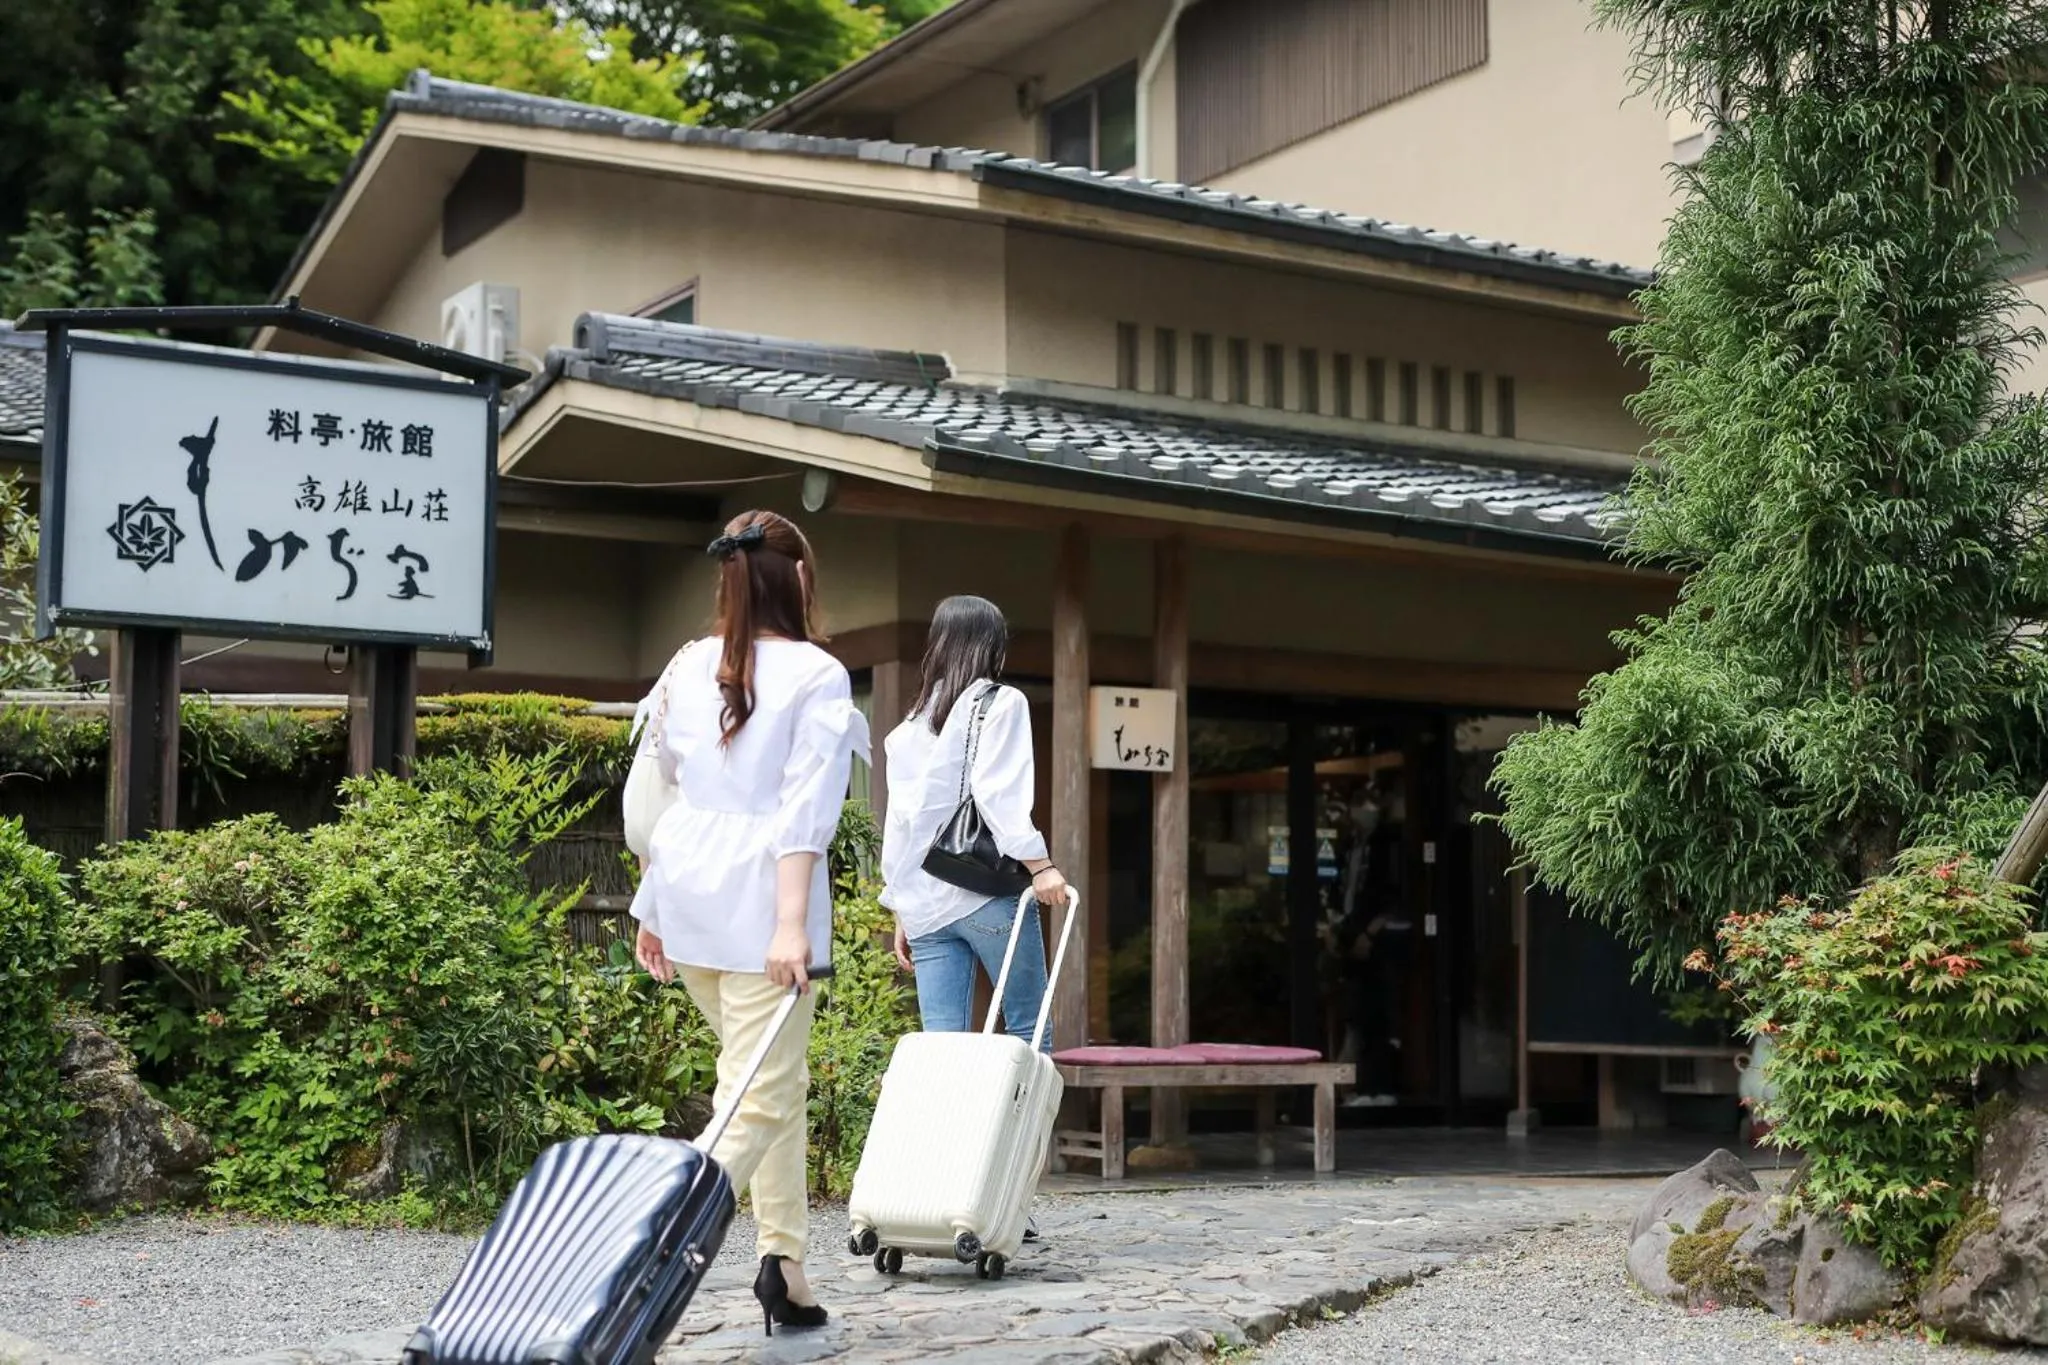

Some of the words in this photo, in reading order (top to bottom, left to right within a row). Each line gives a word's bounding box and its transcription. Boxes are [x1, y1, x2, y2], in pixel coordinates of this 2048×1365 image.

[267, 408, 434, 458] 料亭・旅館
[295, 475, 449, 522] 高雄山荘
